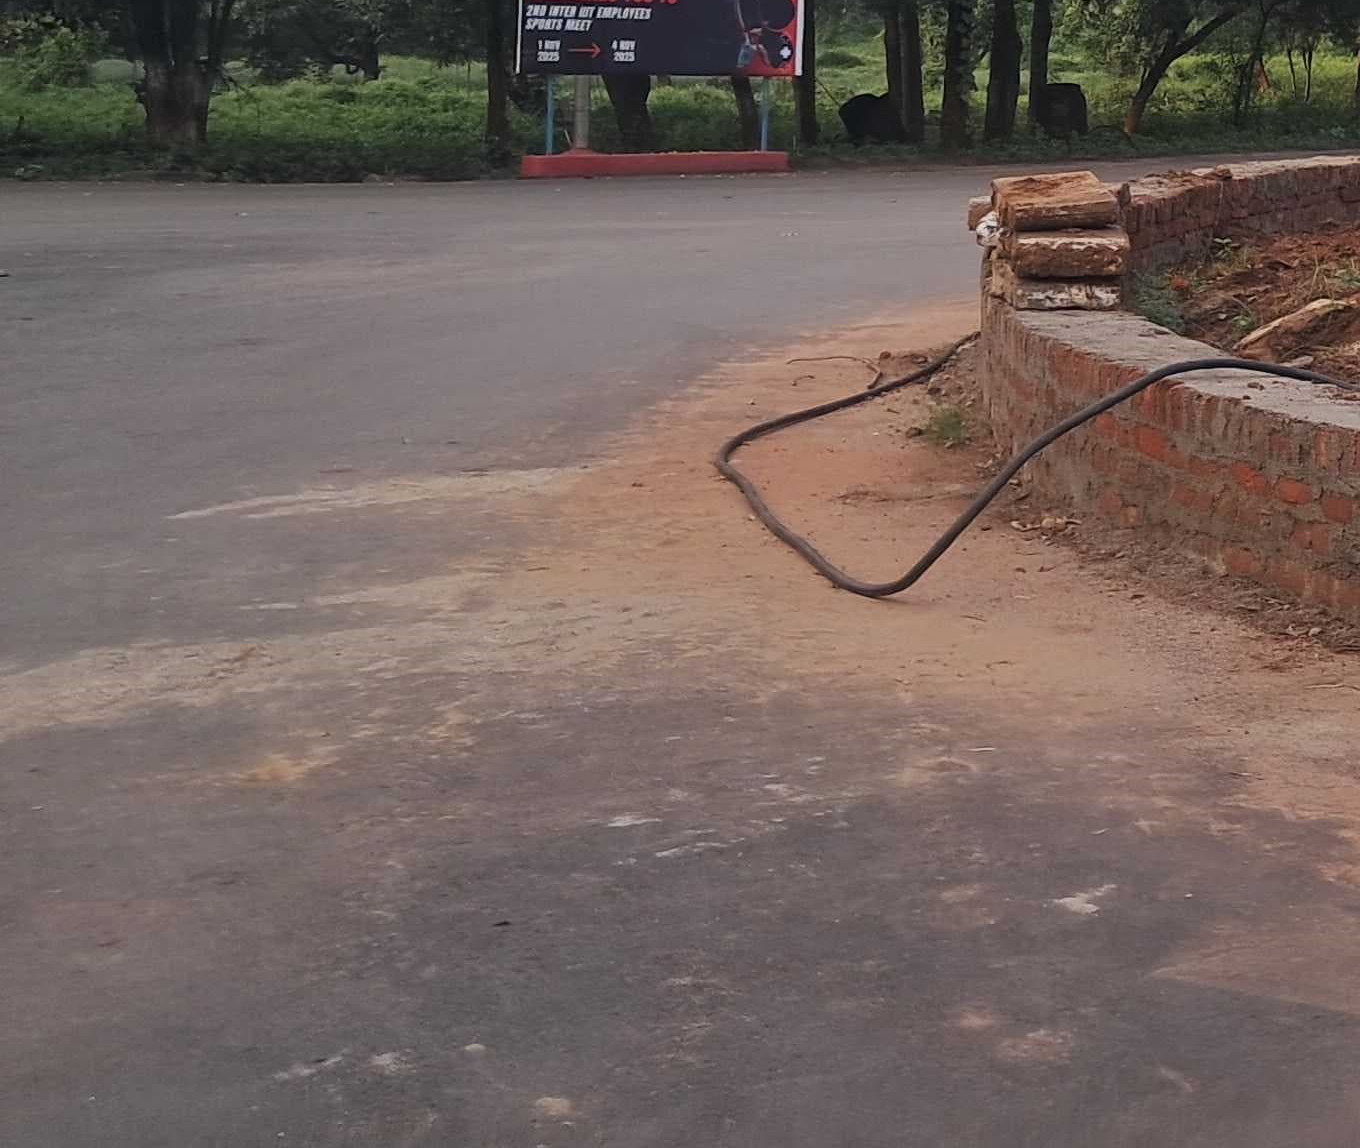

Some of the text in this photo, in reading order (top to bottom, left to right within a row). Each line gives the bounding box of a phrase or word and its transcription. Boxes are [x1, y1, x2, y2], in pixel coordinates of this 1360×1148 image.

[549, 6, 576, 18] INTER
[597, 8, 652, 20] EMPLOYEES
[525, 18, 593, 31] SPORTS MEET
